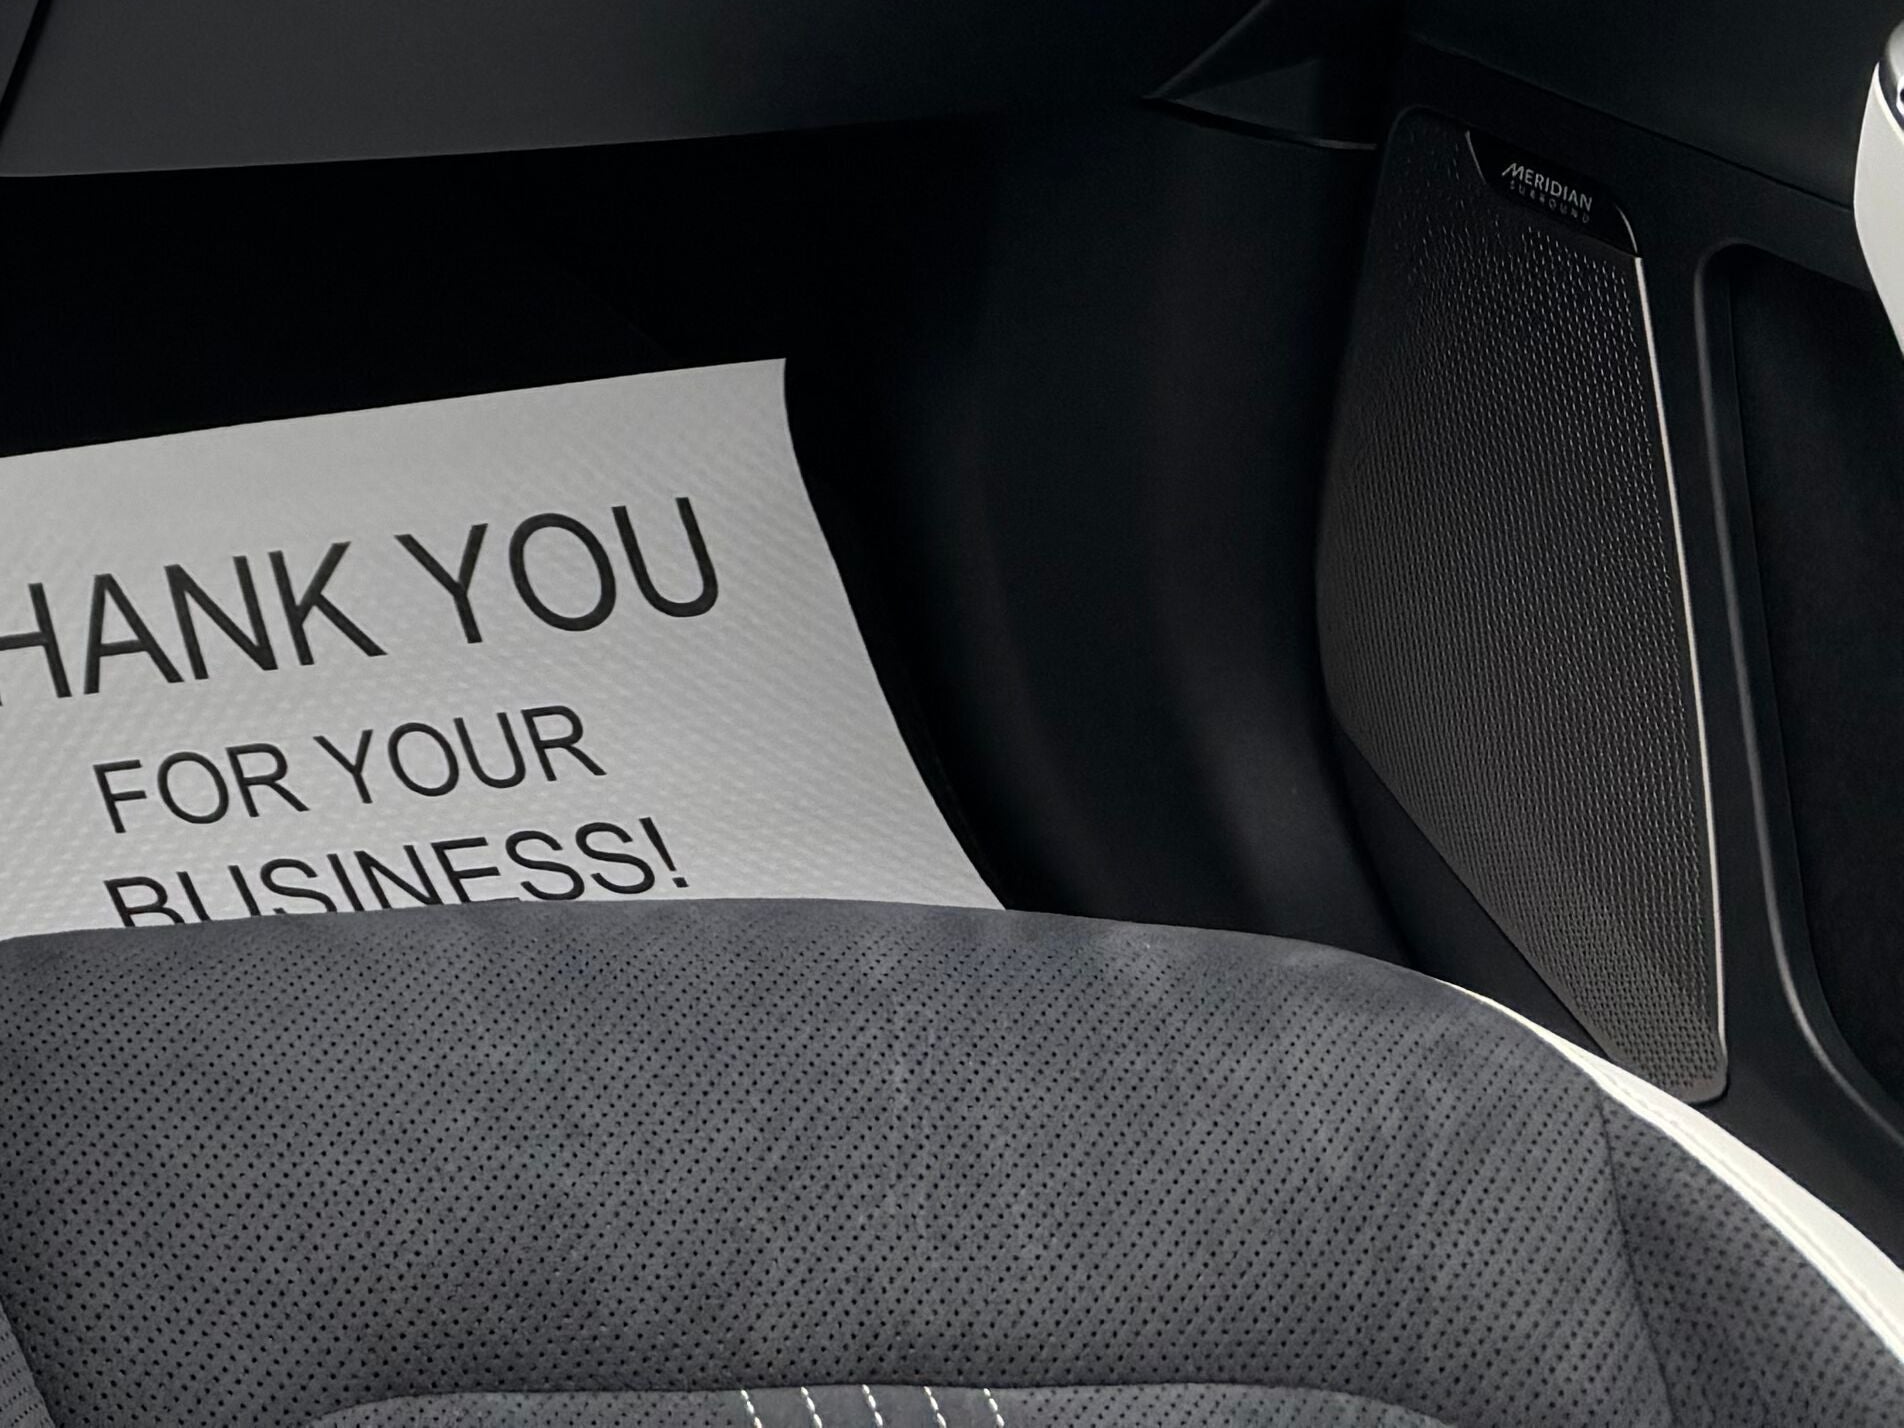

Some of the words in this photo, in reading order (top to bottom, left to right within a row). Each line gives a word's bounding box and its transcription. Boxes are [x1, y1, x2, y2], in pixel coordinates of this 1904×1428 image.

[1501, 162, 1593, 213] MERIDIAN
[394, 495, 723, 646] YOU
[92, 742, 310, 834] FOR
[313, 704, 607, 804] YOUR
[103, 816, 689, 928] BUSINESS!
